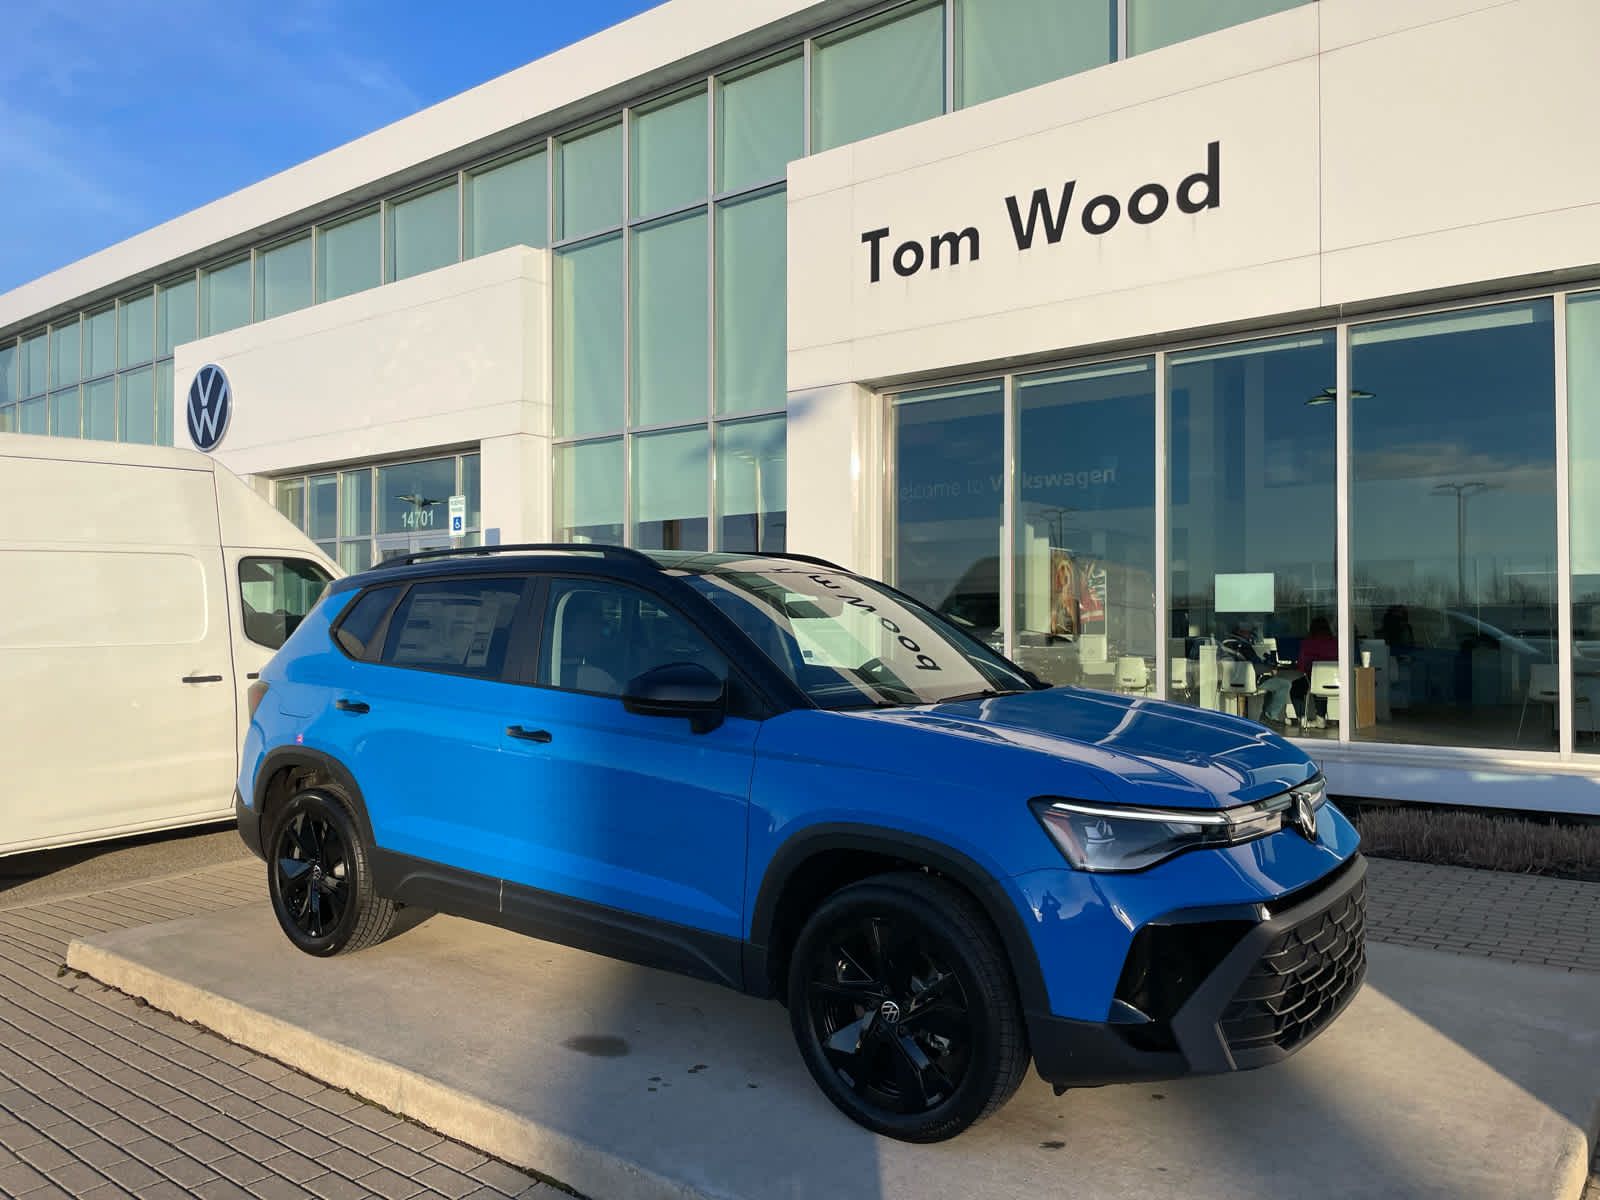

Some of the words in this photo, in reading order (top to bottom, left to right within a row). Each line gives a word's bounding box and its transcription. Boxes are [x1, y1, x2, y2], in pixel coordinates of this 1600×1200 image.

[861, 227, 981, 284] Tom
[1004, 140, 1221, 251] Wood
[401, 509, 434, 528] 14701
